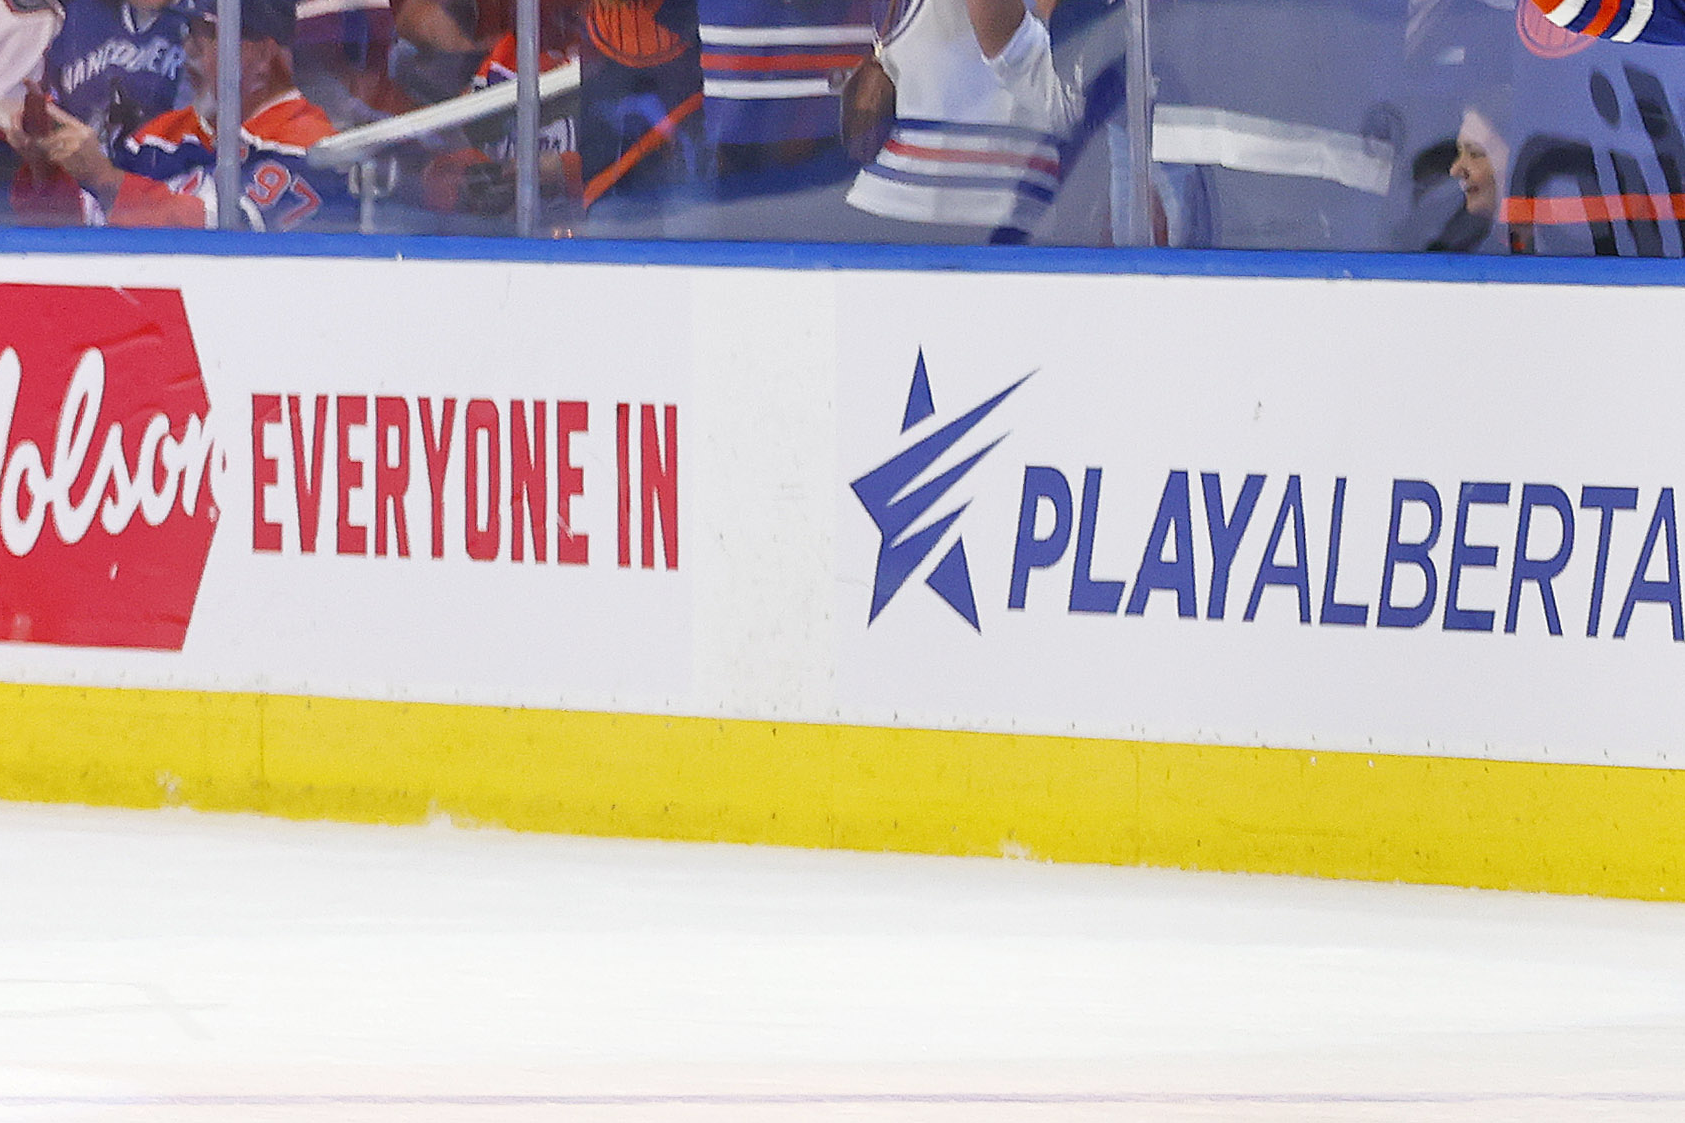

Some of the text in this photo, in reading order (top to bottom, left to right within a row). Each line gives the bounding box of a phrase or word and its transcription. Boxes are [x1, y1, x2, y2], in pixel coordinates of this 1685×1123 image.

[251, 392, 680, 572] EVERYONE IN
[1007, 464, 1685, 643] PLAYALBERTA
